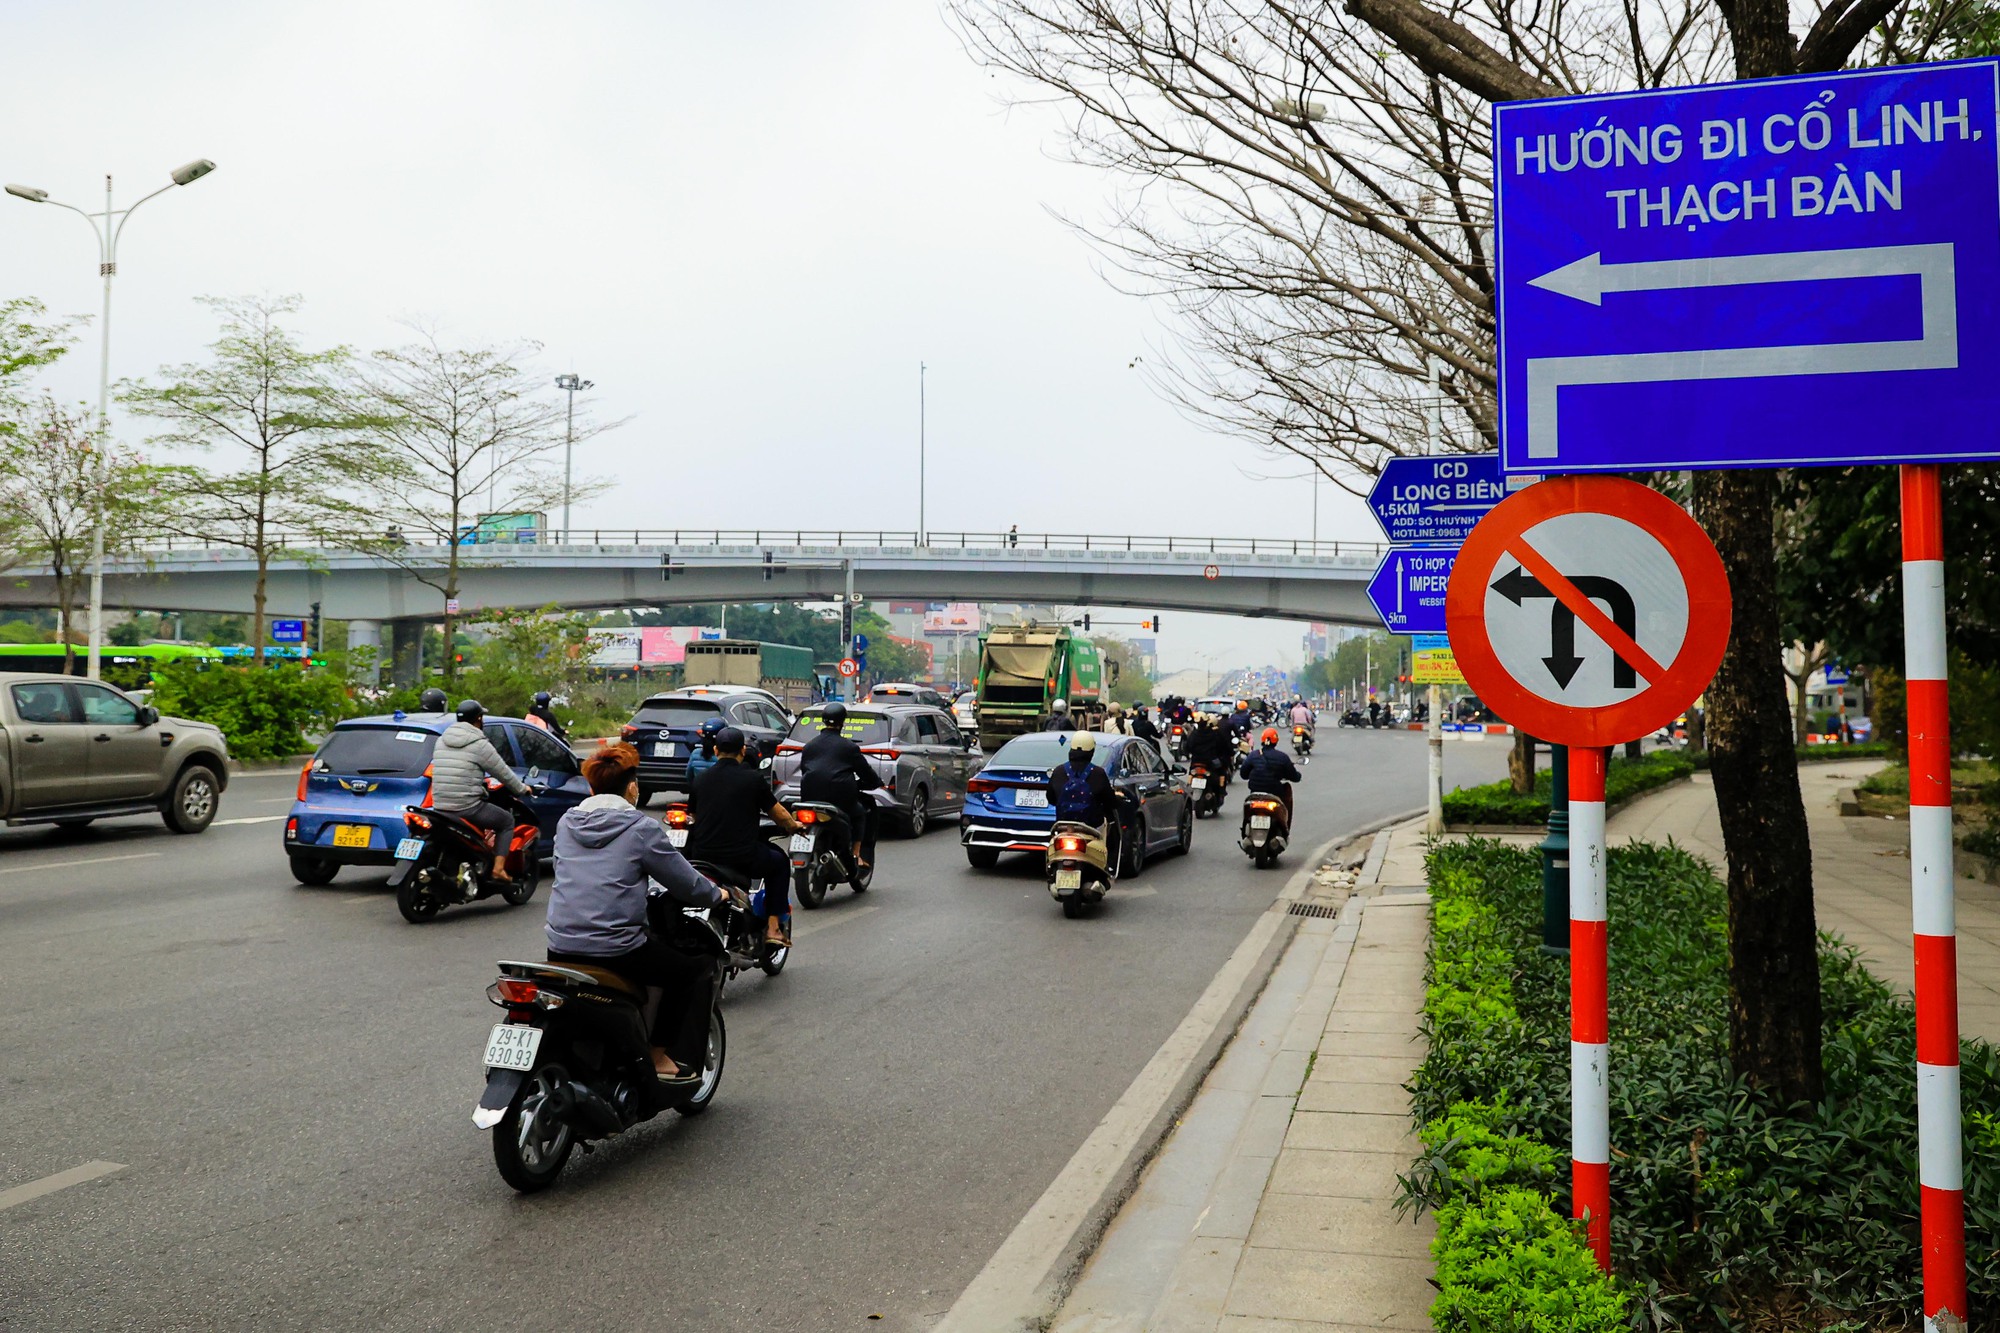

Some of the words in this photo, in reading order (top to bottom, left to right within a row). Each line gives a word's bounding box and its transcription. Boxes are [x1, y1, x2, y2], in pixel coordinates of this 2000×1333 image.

[1515, 116, 1683, 175] HƯỚNG
[1699, 117, 1746, 160] ĐI
[1763, 90, 1836, 154] CỔ
[1848, 98, 1983, 149] LINH,
[1606, 178, 1776, 232] THẠCH
[1792, 163, 1902, 217] BÀN
[1433, 462, 1468, 479] ICD
[1393, 484, 1451, 501] LONG
[1456, 479, 1504, 499] BIÊN
[1378, 503, 1420, 518] 1,5KM
[1392, 517, 1417, 526] ADD:
[1388, 612, 1407, 624] 5km
[496, 1028, 533, 1048] 29-K1
[487, 1047, 532, 1067] 930.93
